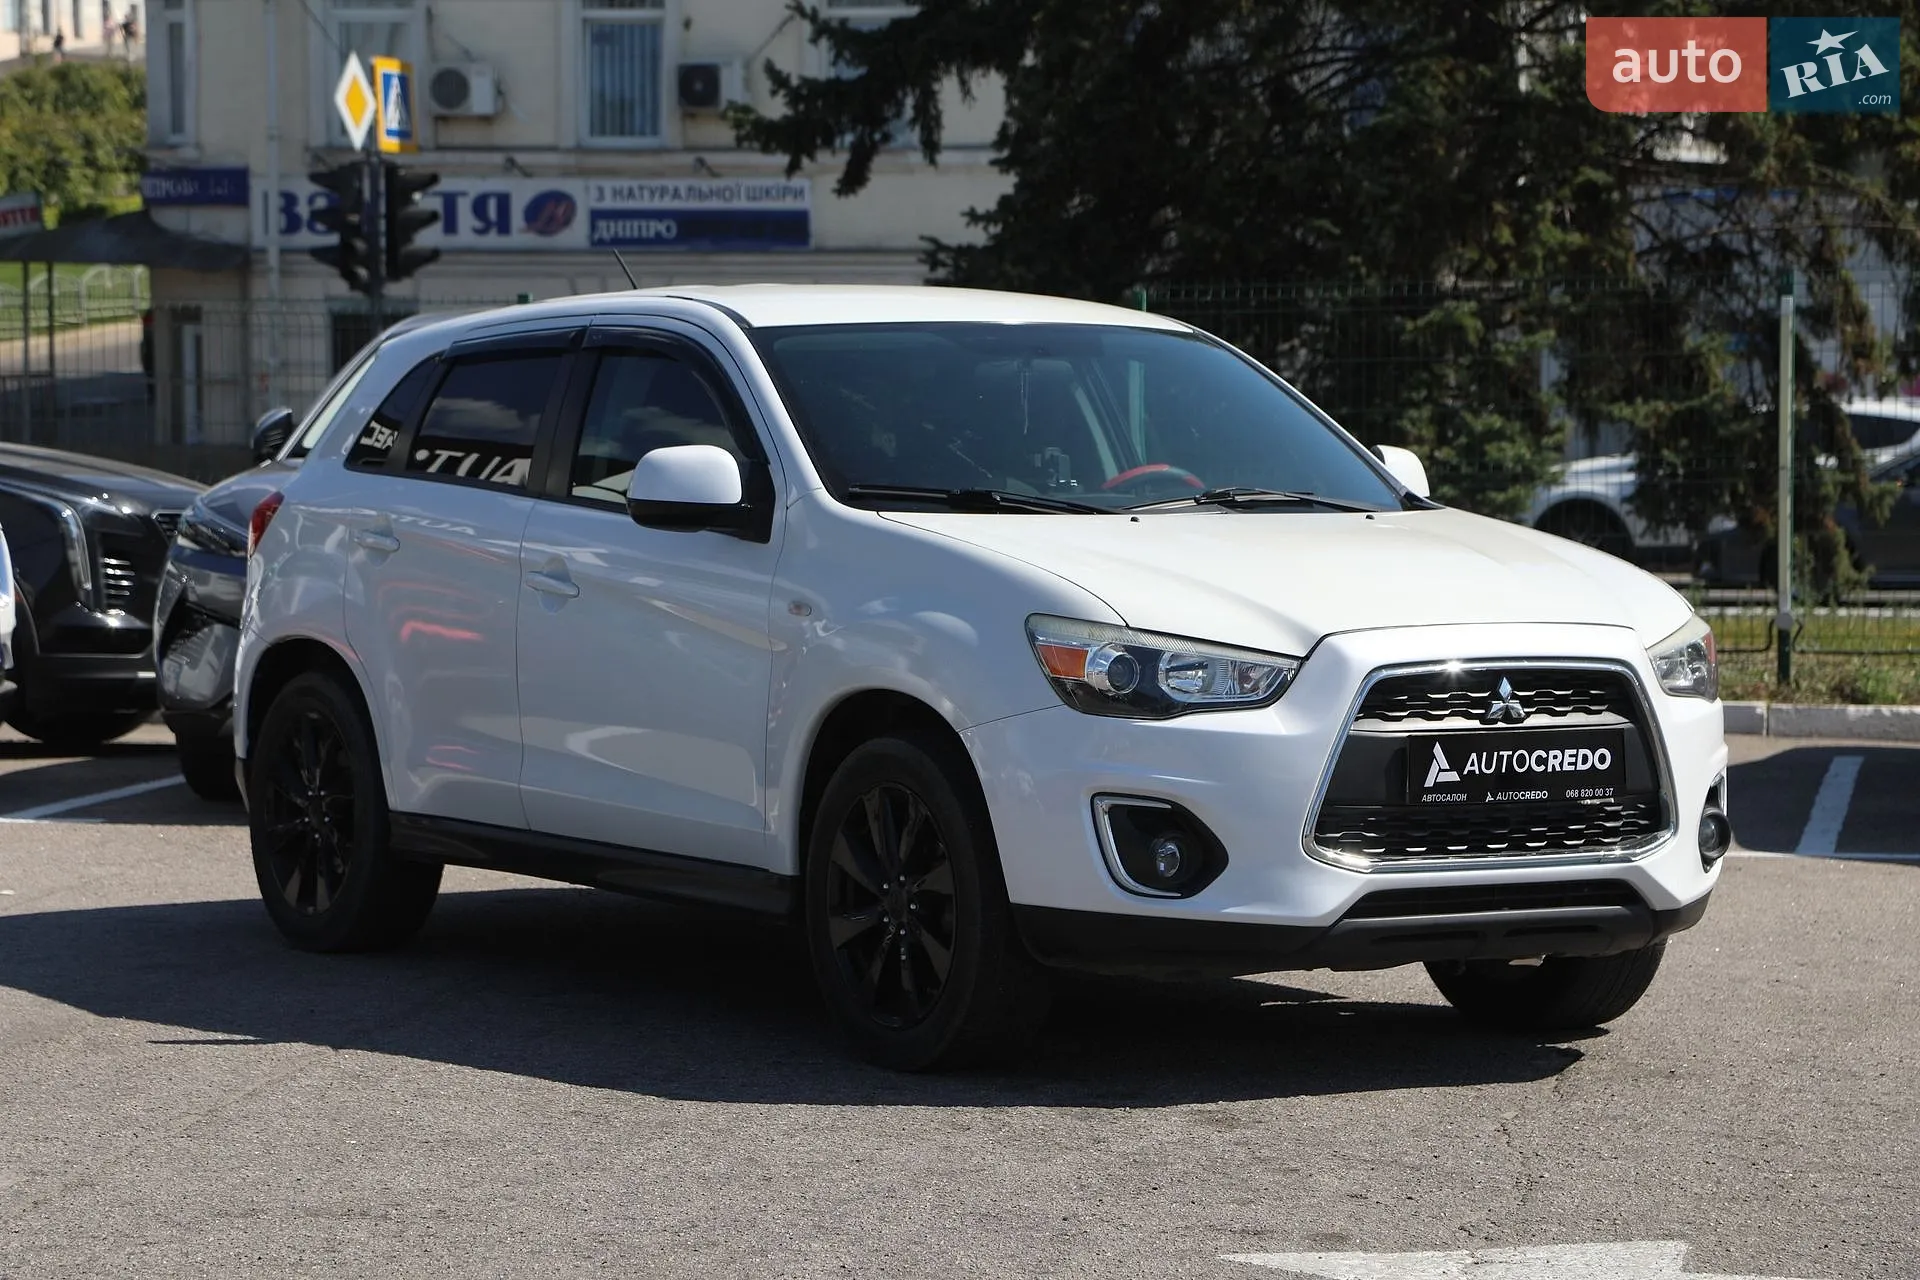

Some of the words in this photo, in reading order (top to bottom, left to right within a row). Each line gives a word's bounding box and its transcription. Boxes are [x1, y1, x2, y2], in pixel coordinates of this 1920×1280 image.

[612, 182, 742, 202] НАТУРАЛЬНОЇ
[746, 183, 807, 202] ШКІРИ
[593, 218, 678, 242] ДНІПРО
[1462, 747, 1612, 776] AUTOCREDO
[1421, 792, 1468, 803] АВТОСАЛОН
[1495, 789, 1549, 801] AUTOCREDO
[1565, 789, 1579, 798] 068
[1580, 788, 1594, 798] 820
[1594, 788, 1604, 797] 00
[1604, 787, 1614, 797] 37
